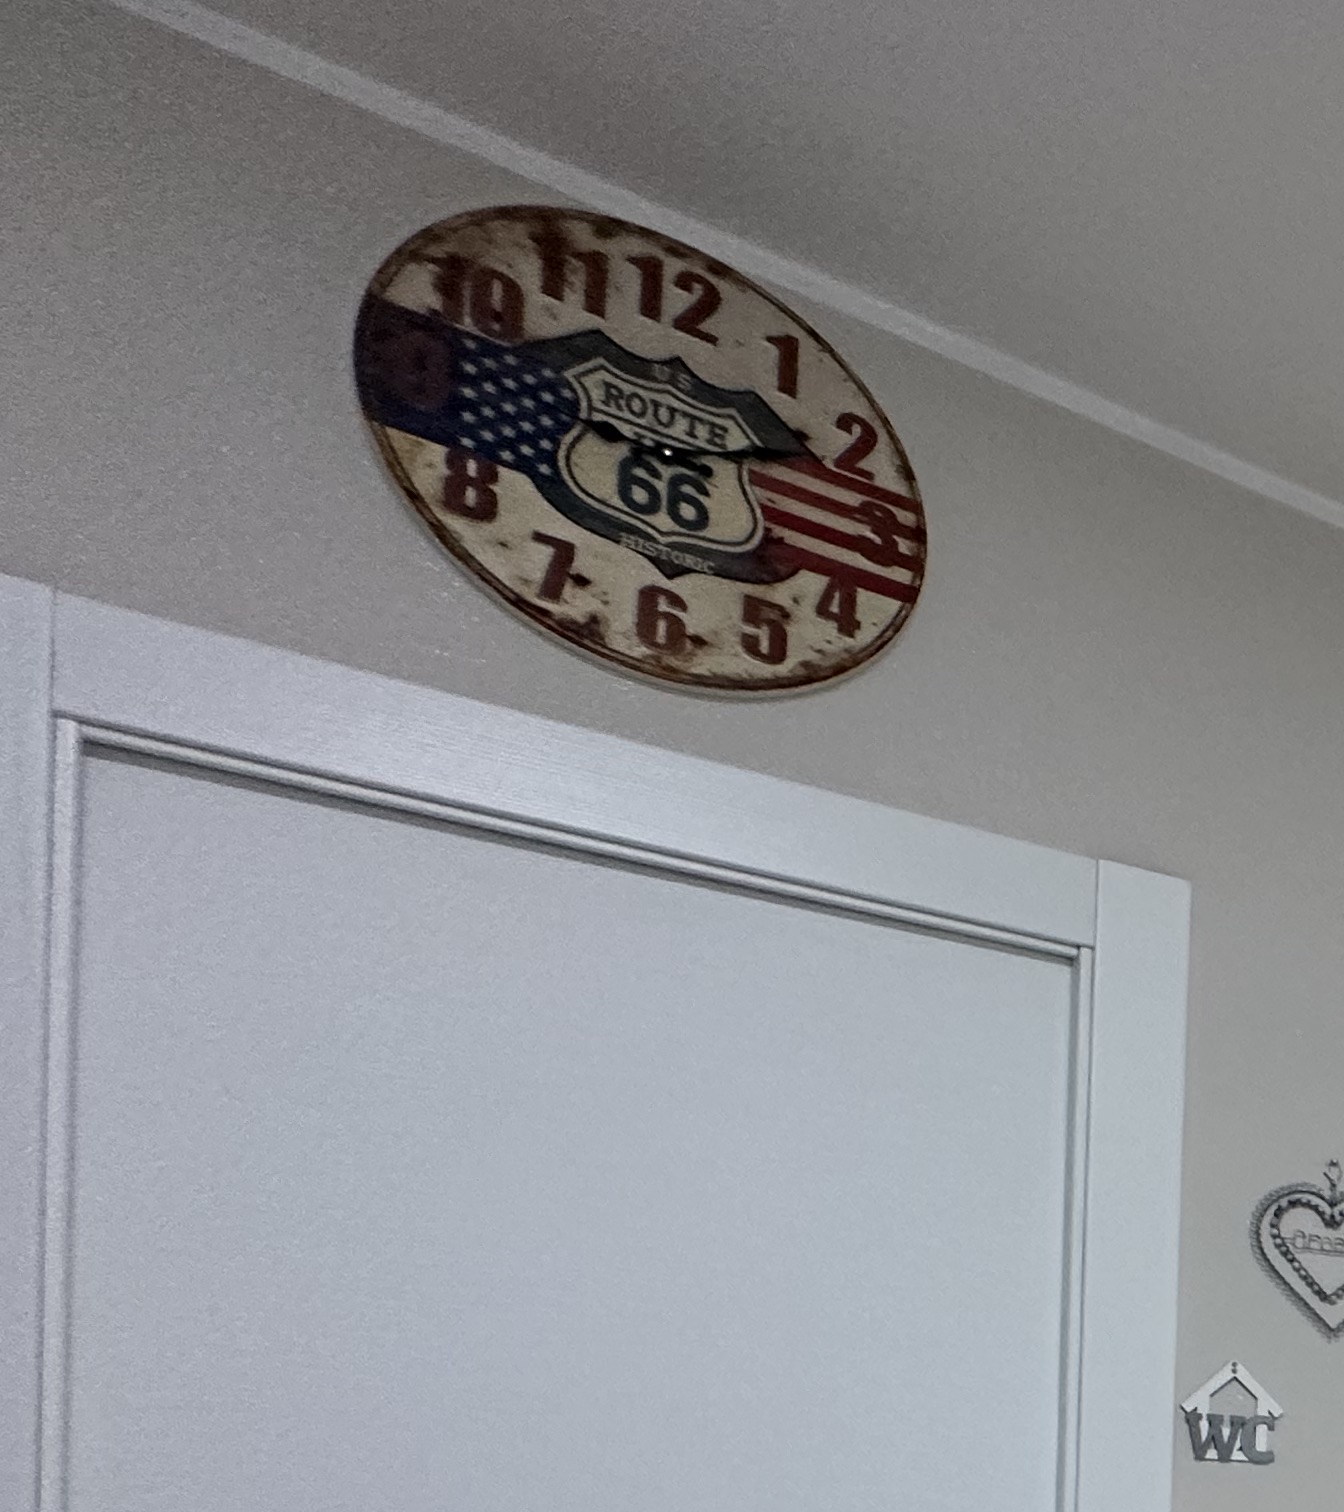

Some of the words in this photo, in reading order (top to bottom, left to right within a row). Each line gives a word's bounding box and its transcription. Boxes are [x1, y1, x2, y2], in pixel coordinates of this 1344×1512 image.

[426, 253, 526, 343] 10
[534, 228, 610, 320] 11
[627, 254, 724, 346] 12
[766, 334, 801, 398] 1
[602, 380, 730, 450] ROUTE
[834, 412, 879, 480] 2
[442, 447, 499, 523] 8
[616, 453, 712, 533] 66
[531, 530, 575, 602] 7
[620, 531, 716, 574] HISTORIC
[635, 584, 689, 655] 6
[740, 596, 792, 665] 5
[815, 577, 862, 637] 4
[1184, 1412, 1275, 1465] WC
